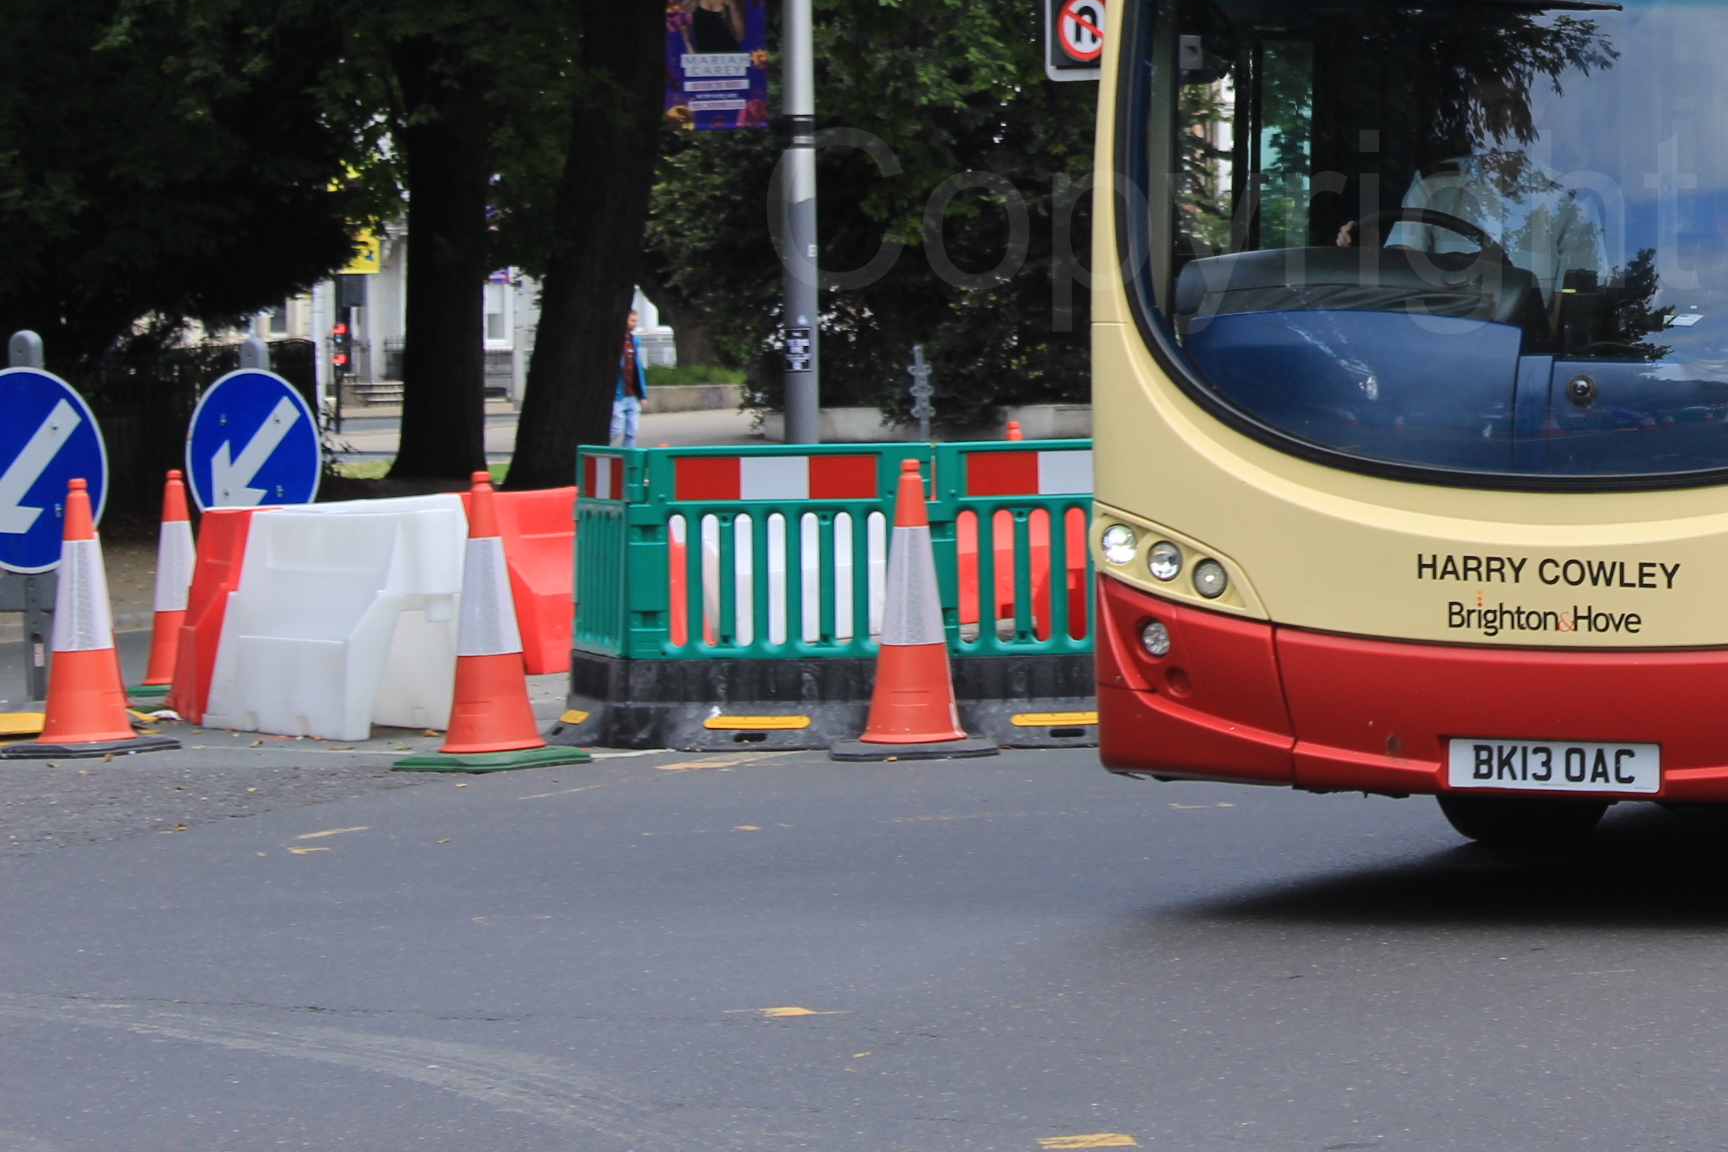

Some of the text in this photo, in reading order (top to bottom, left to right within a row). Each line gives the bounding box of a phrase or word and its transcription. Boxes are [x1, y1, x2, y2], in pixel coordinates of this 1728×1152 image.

[683, 55, 749, 65] MARIAH
[690, 65, 741, 76] CAREY
[1416, 553, 1680, 588] HARRY COWLEY
[1472, 744, 1635, 783] BK13 OAC
